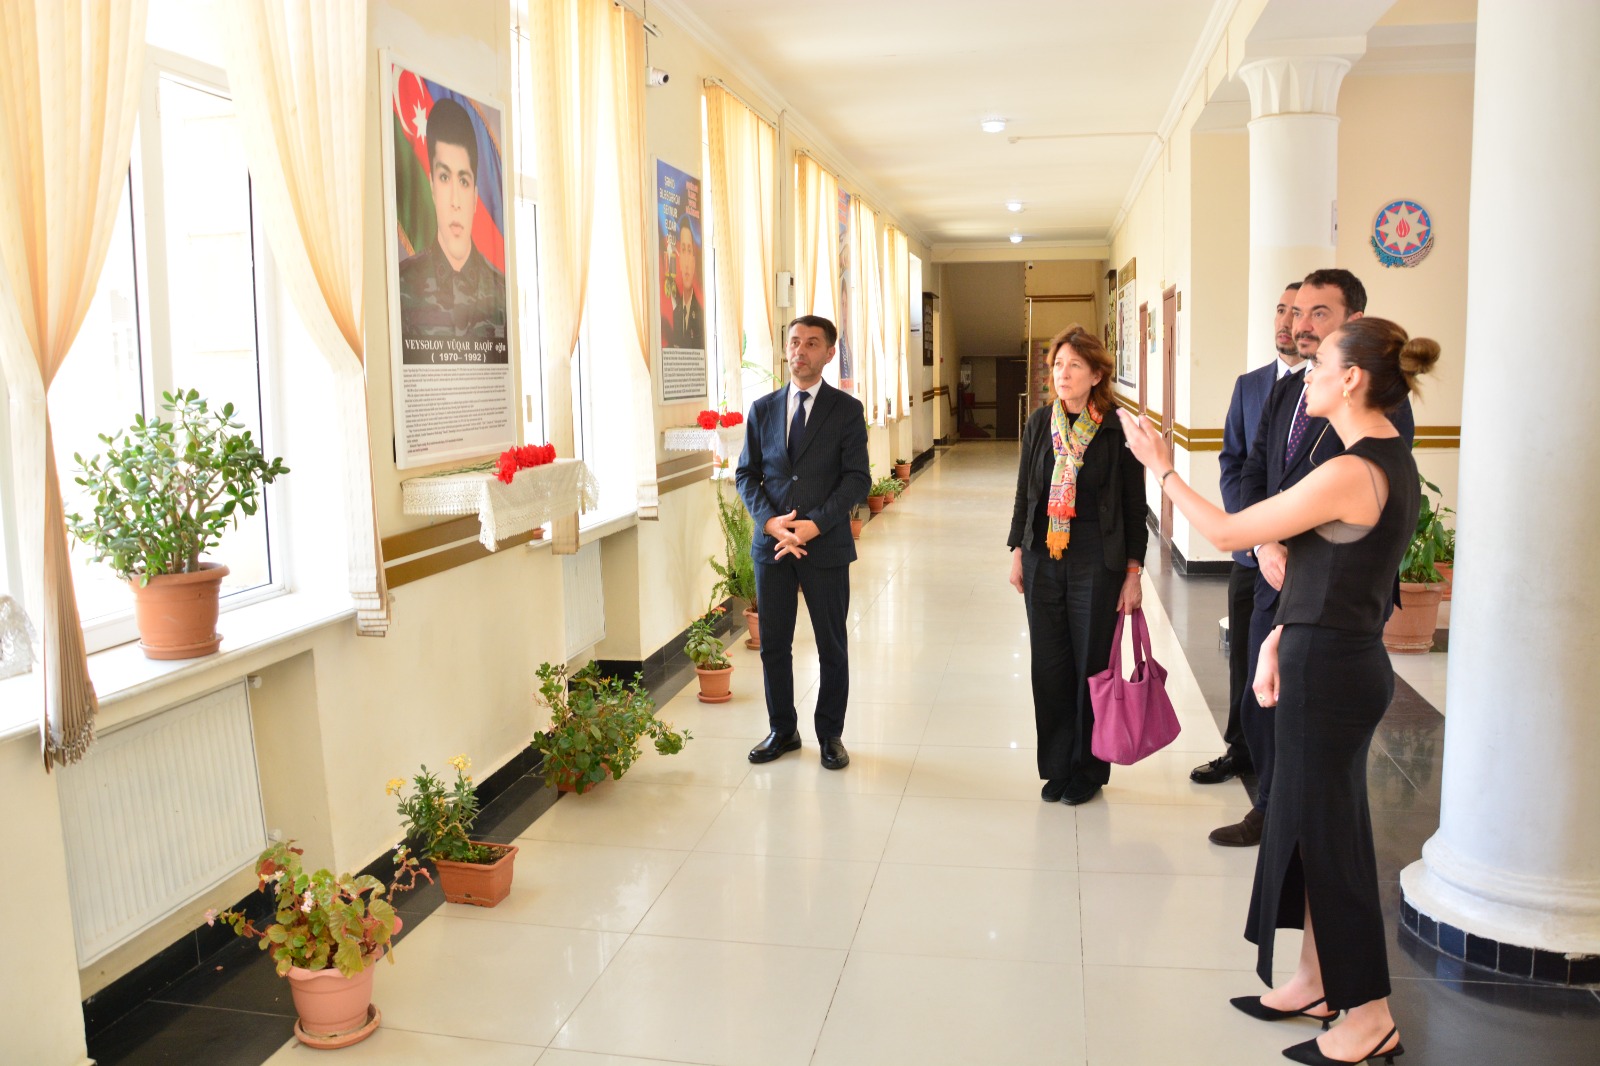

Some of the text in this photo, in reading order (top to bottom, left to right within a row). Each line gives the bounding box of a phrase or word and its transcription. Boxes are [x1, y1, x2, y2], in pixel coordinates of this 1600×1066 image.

[405, 339, 444, 350] VEYSƏLOV
[446, 339, 471, 352] VÜQAR
[474, 340, 494, 353] RAQİF
